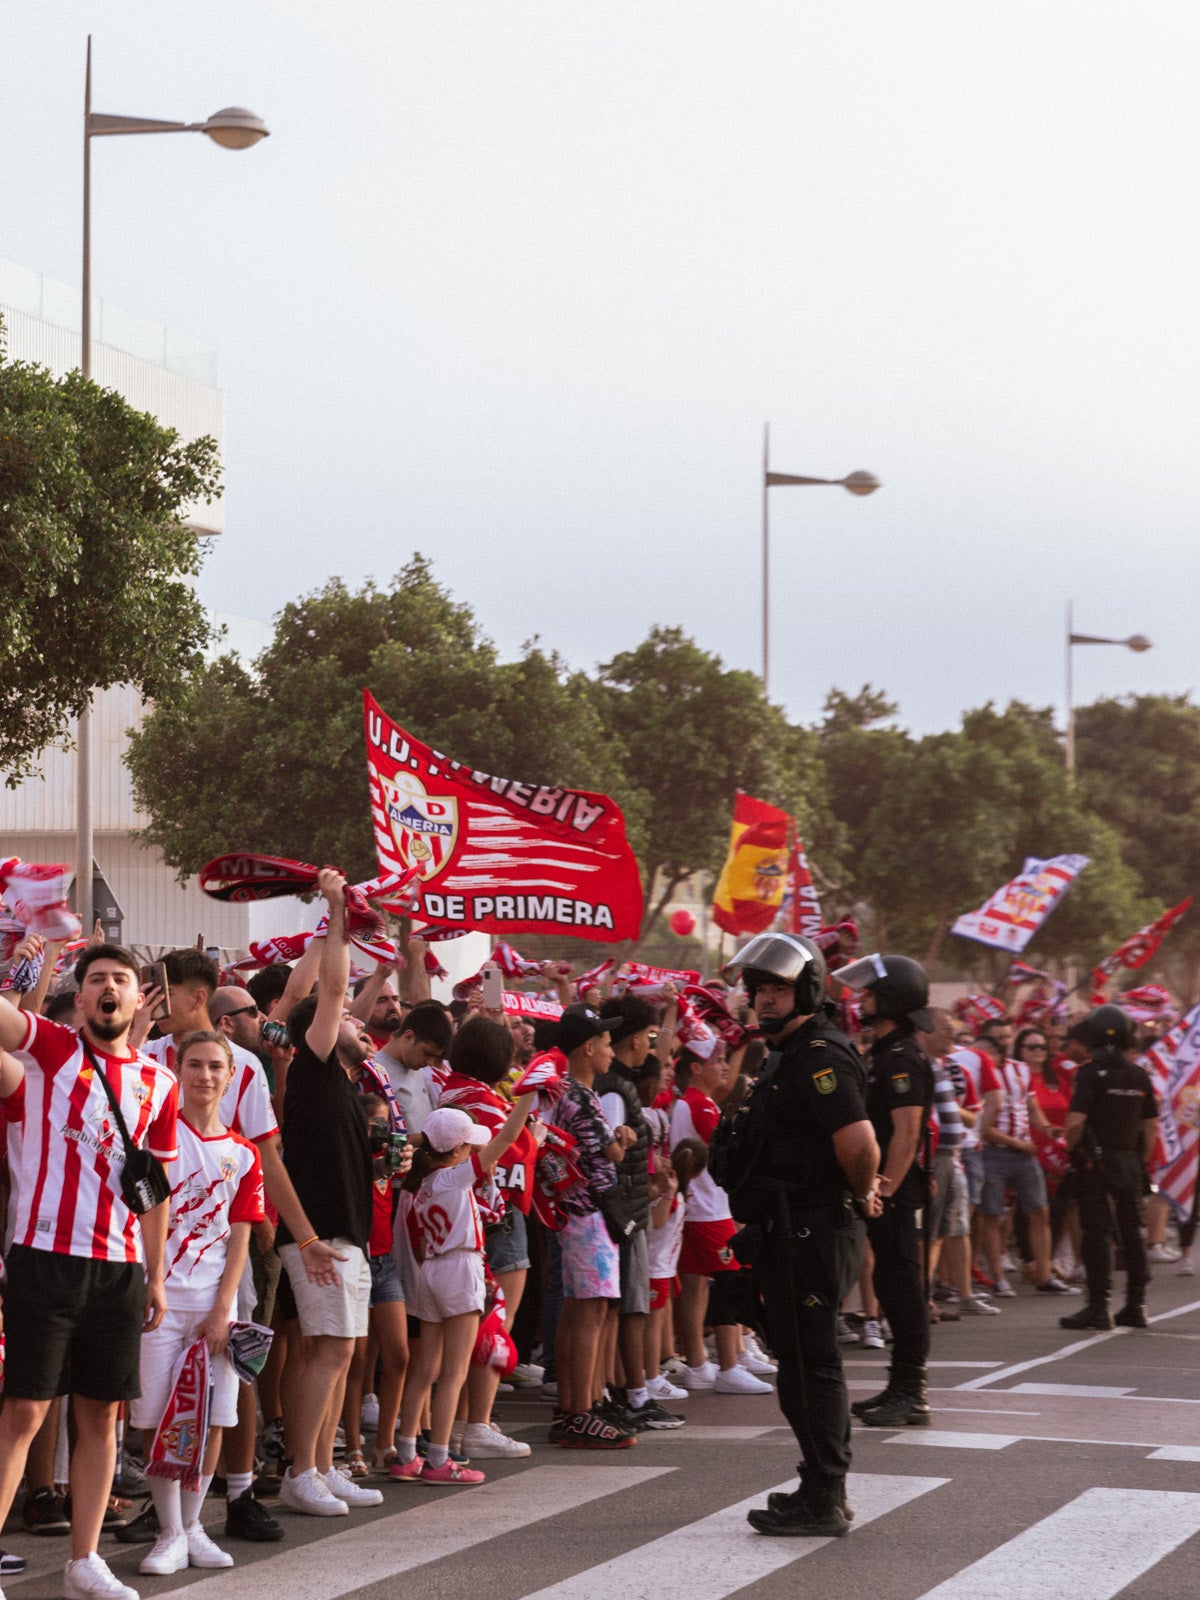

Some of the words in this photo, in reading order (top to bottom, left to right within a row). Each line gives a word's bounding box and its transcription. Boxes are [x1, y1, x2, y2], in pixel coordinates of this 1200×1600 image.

[389, 807, 451, 836] ALMERIA
[424, 894, 466, 920] DE
[473, 895, 614, 929] PRIMERA
